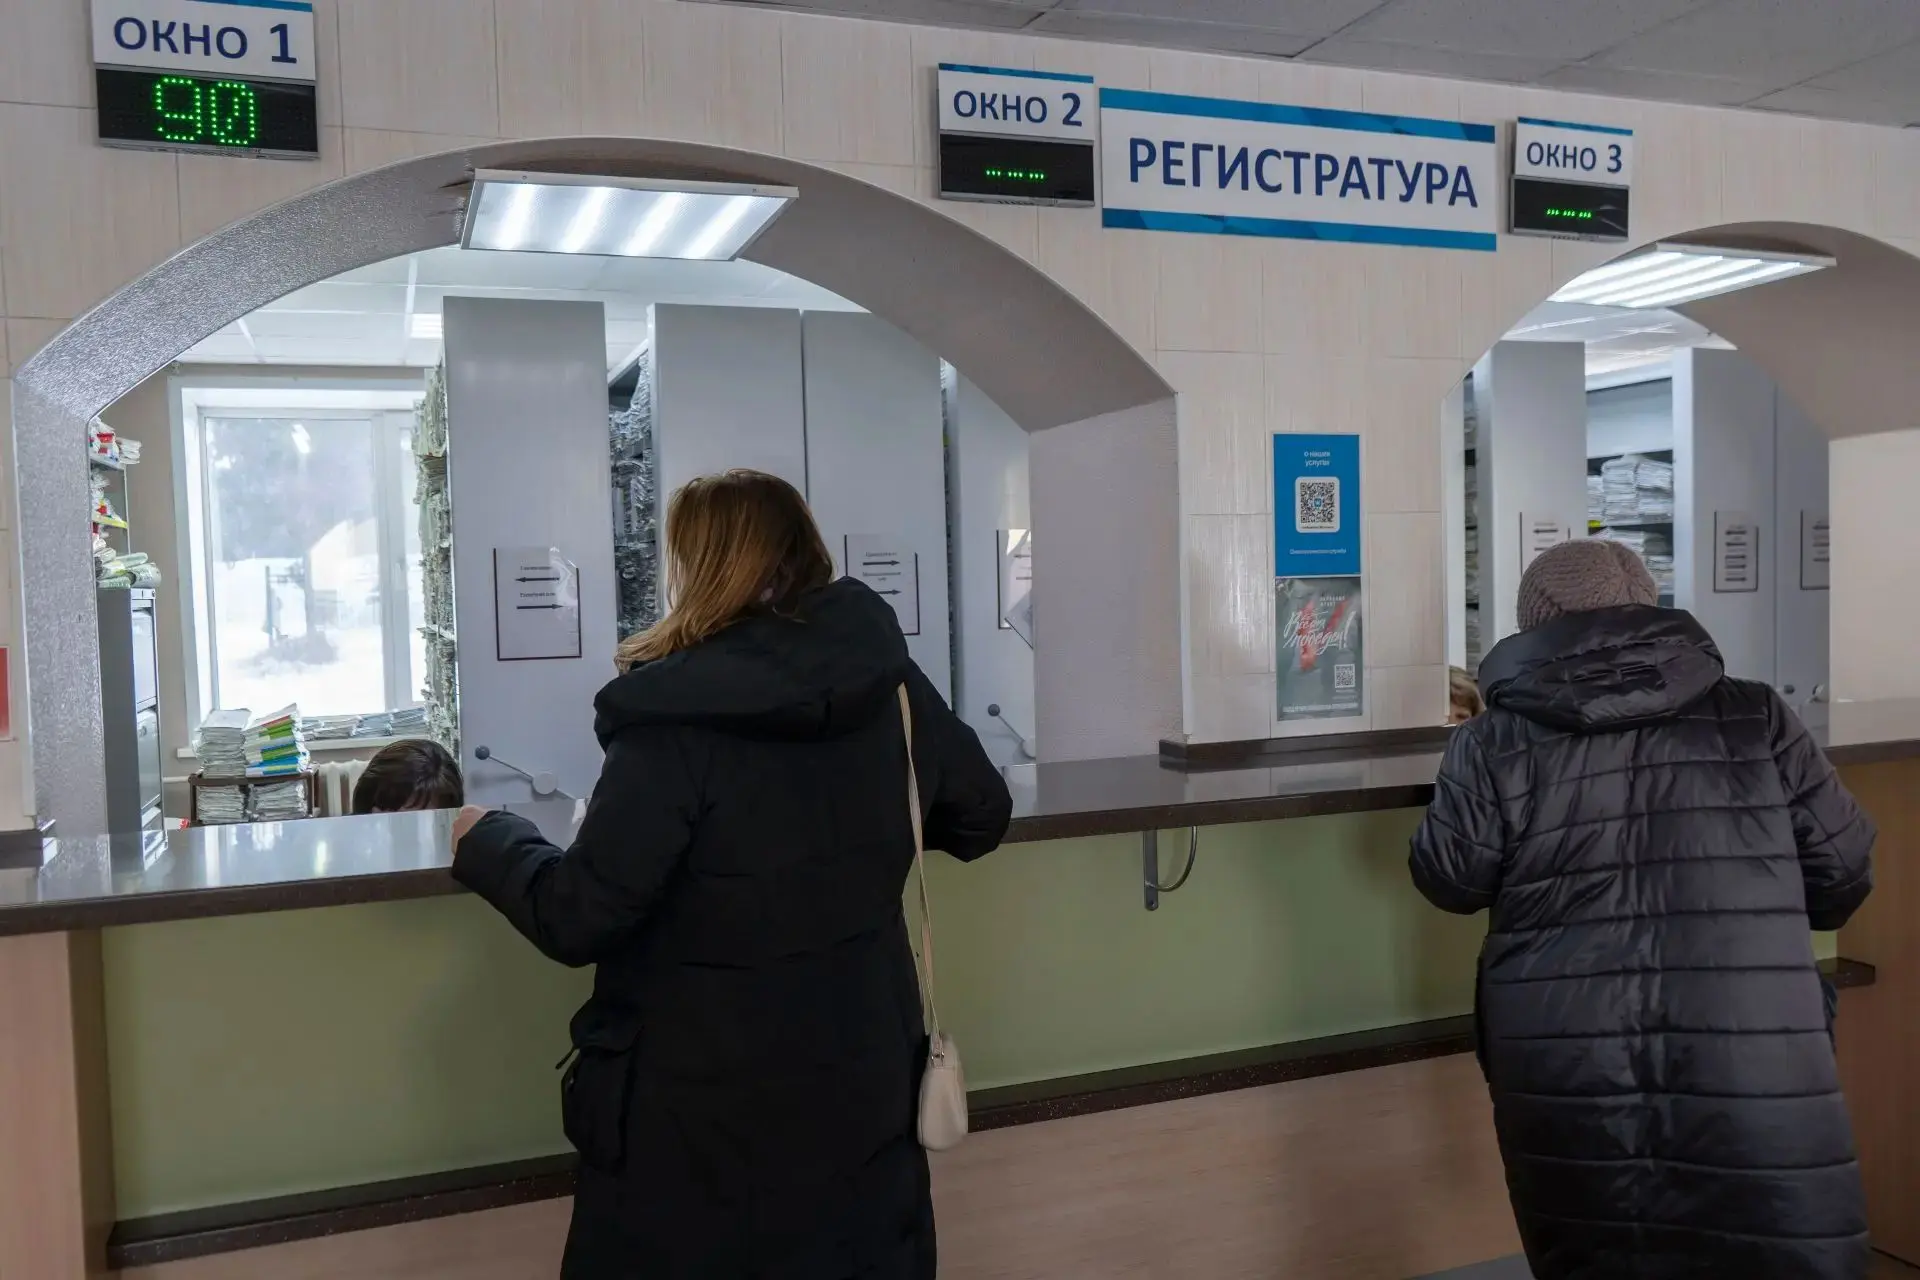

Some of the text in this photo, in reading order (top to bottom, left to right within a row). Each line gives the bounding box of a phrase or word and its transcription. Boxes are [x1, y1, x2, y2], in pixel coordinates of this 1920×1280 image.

[113, 16, 298, 64] ОКНО 1
[155, 77, 256, 145] 90
[952, 90, 1083, 127] ОКНО 2
[1128, 136, 1479, 208] РЕГИСТРАТУРА
[1525, 140, 1624, 174] ОКНО 3
